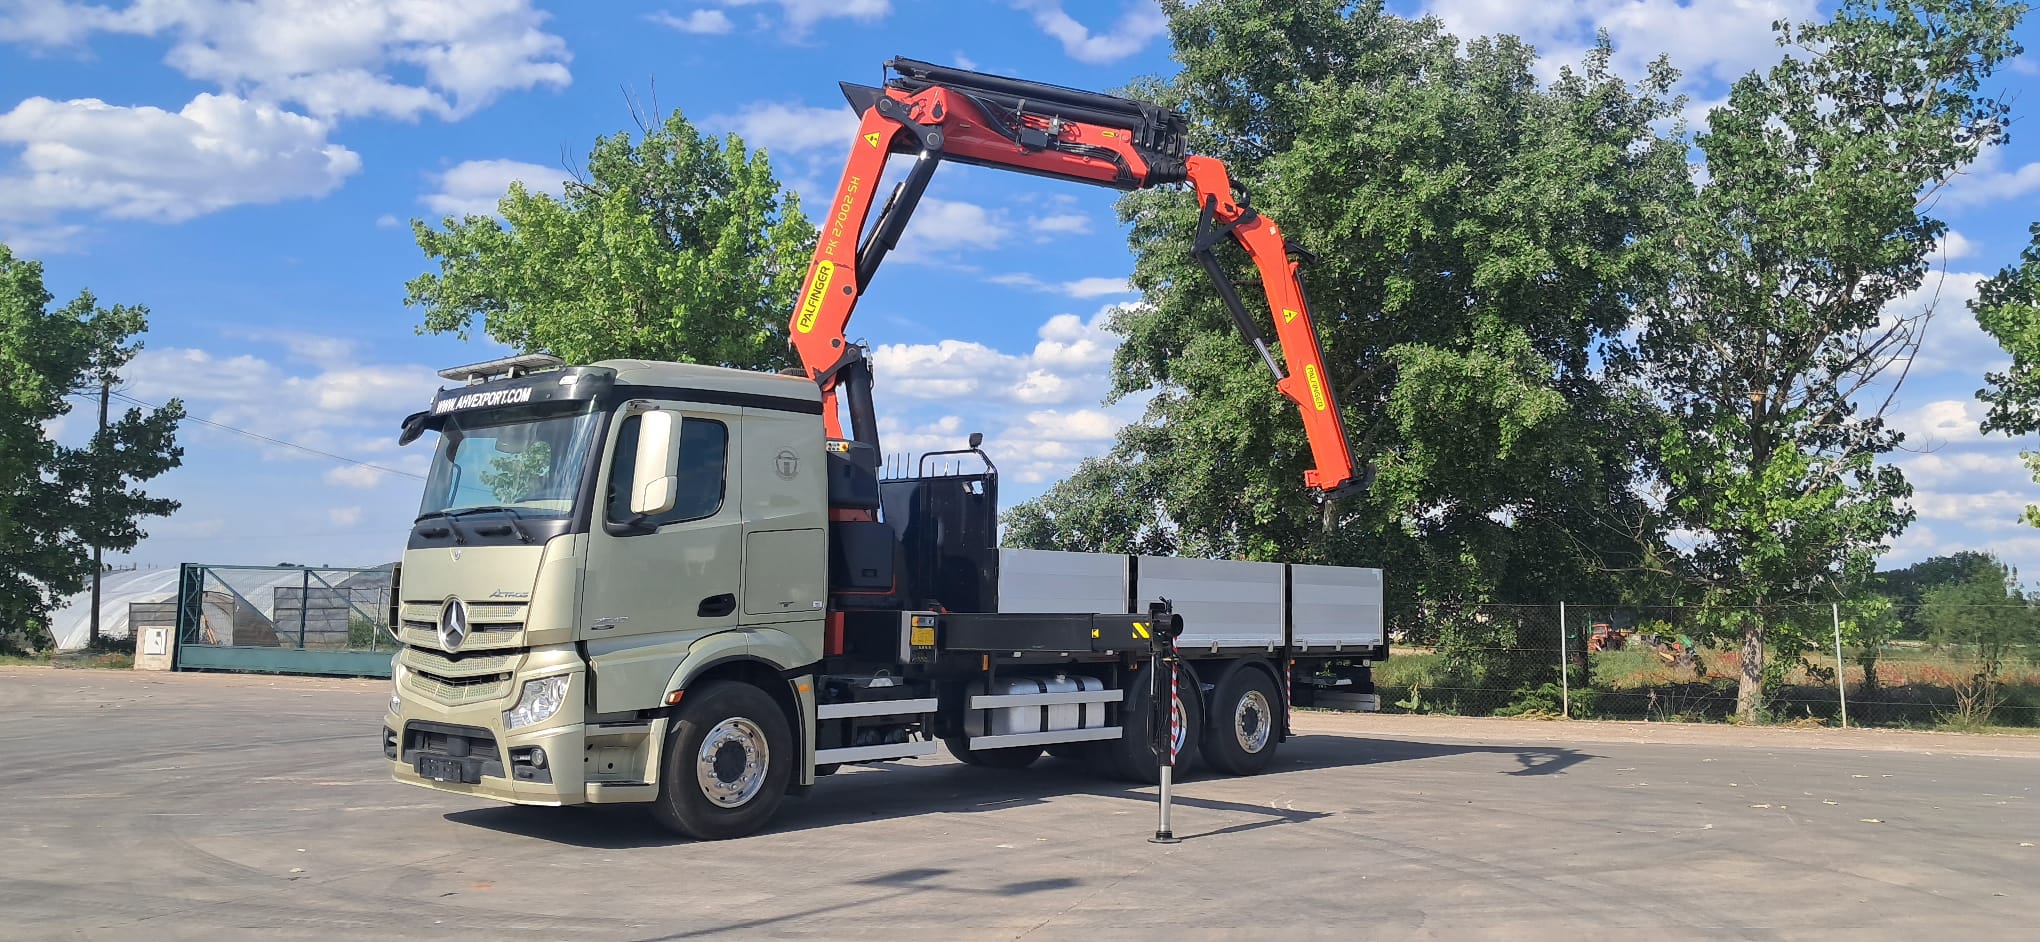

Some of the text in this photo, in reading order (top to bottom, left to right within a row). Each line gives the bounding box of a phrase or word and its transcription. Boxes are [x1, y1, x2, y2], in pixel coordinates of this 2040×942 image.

[825, 176, 861, 255] PK 27002 SH
[800, 265, 830, 328] PALFINGER
[435, 387, 532, 414] WWW.AHVEXPORT.COM
[1307, 367, 1323, 407] PALFINGER
